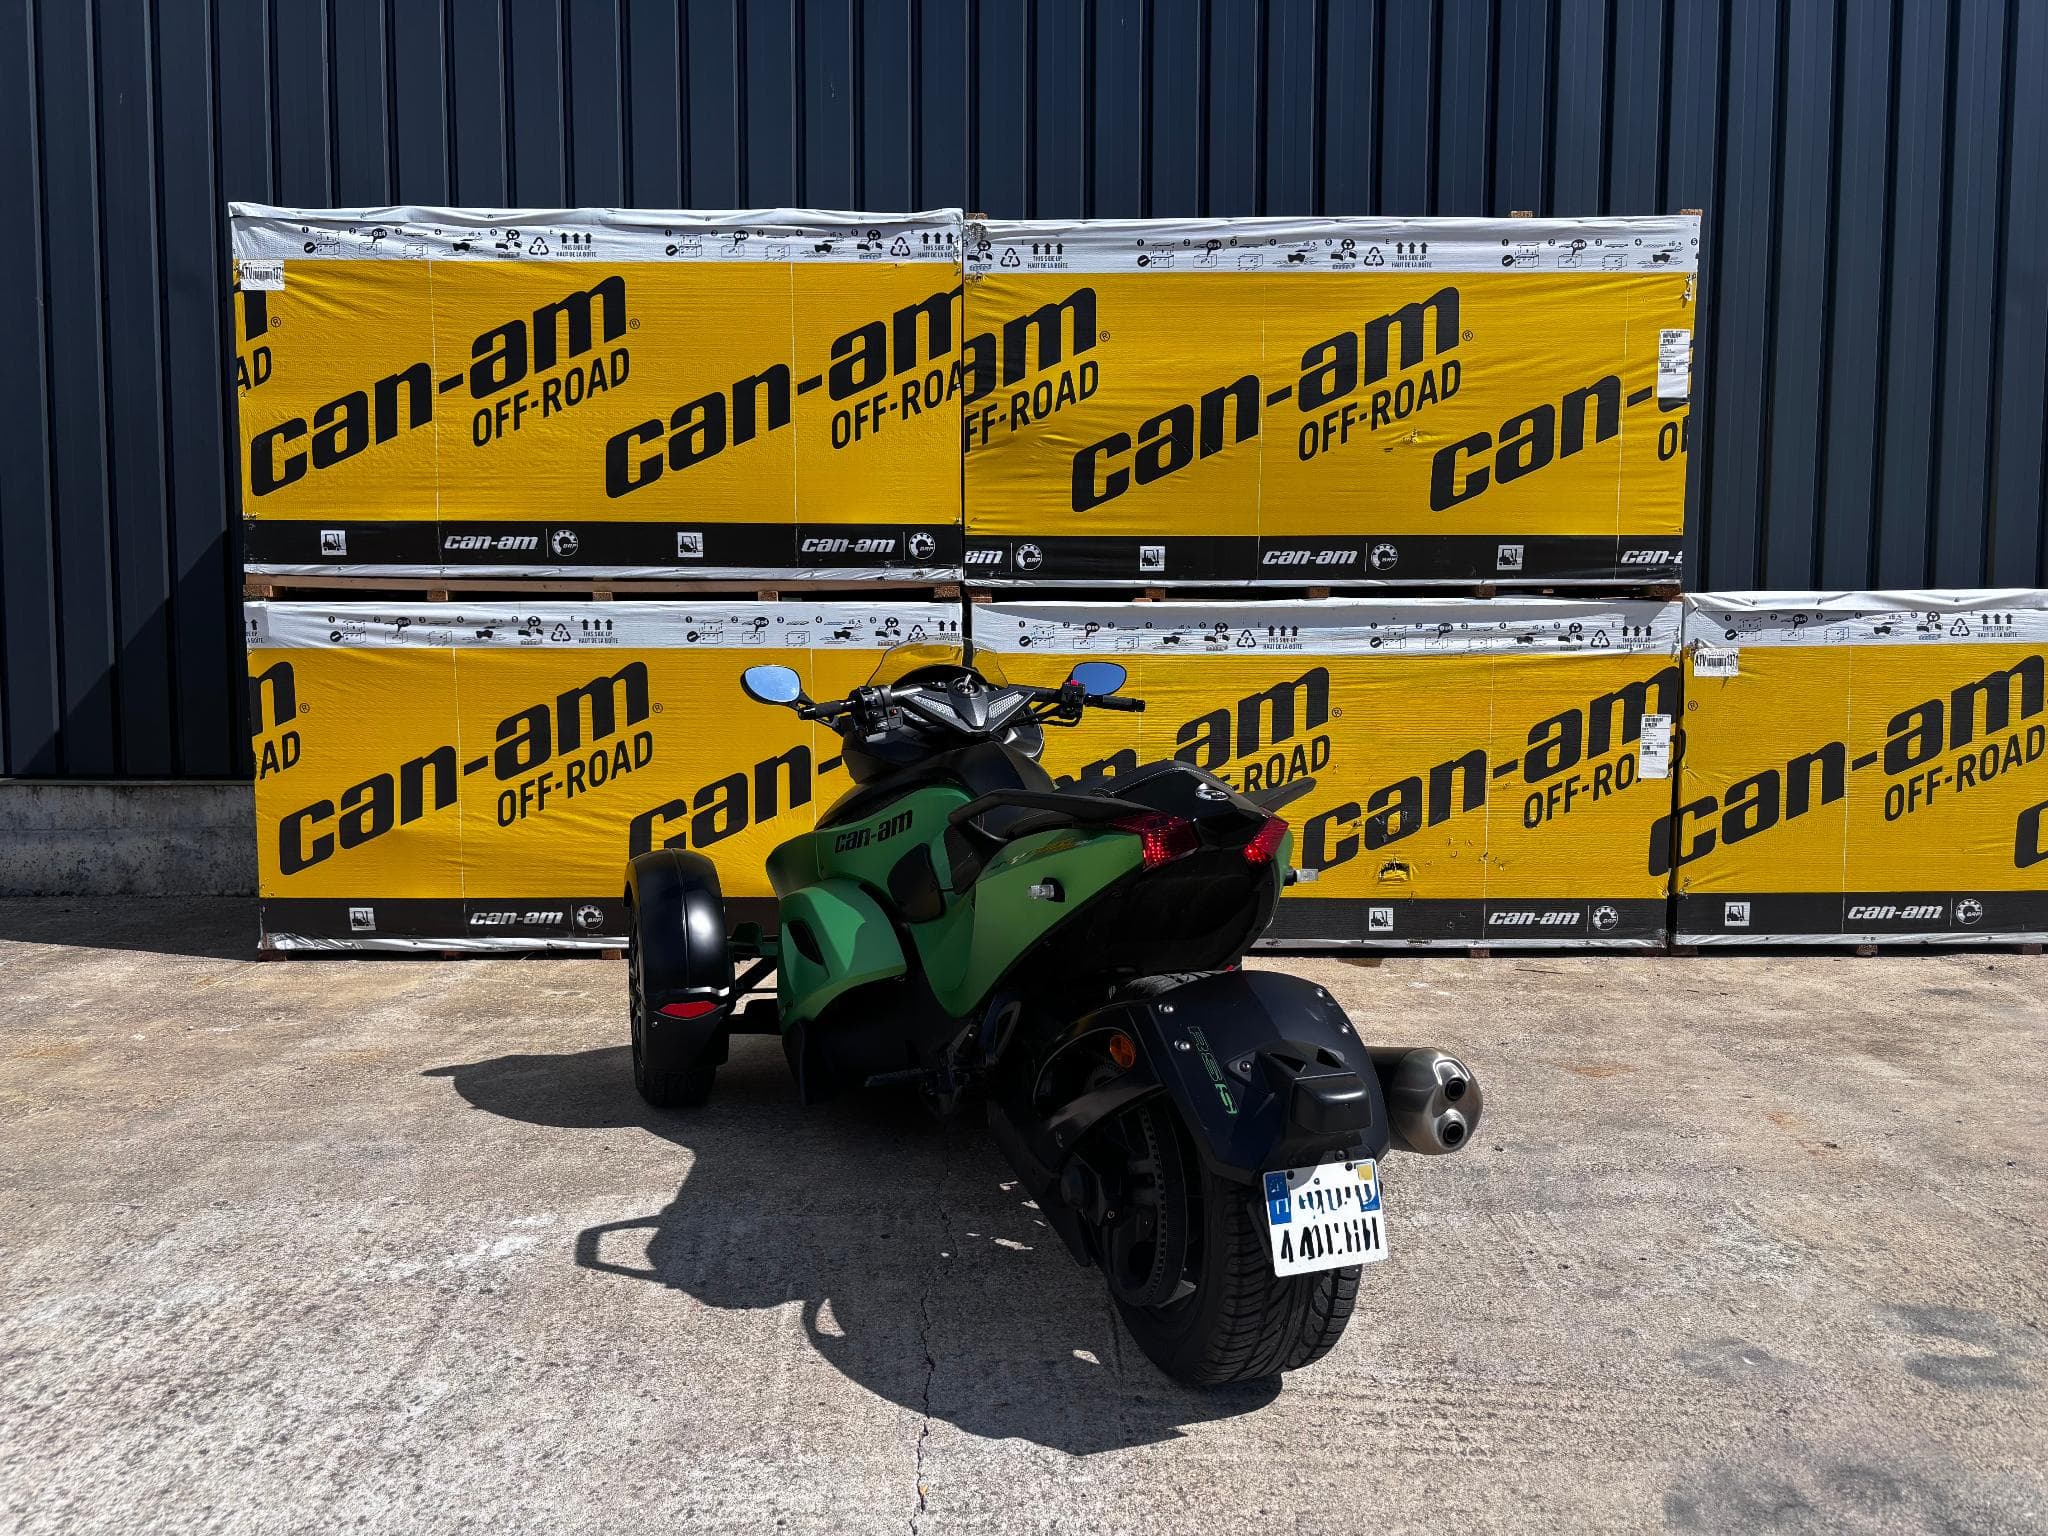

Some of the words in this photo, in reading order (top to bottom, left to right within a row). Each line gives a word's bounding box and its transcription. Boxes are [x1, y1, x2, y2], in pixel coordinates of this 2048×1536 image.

[251, 275, 627, 497] can-am
[472, 348, 630, 447] OFF-ROAD
[1072, 287, 1460, 513] can-am
[1298, 360, 1461, 462] OFF-ROAD
[443, 535, 539, 551] can-am
[801, 537, 896, 553] can-am
[1262, 549, 1357, 565] can-am
[279, 661, 650, 876] can-am
[497, 731, 653, 828] OFF-ROAD
[629, 745, 843, 861] can-
[1302, 666, 1684, 872] can-am
[1649, 655, 2045, 877] can-am
[1884, 725, 2046, 823] OFF-ROAD
[833, 809, 913, 854] can-am
[469, 911, 564, 926] can-am
[1488, 911, 1580, 926] can-am
[1847, 905, 1944, 920] can-am
